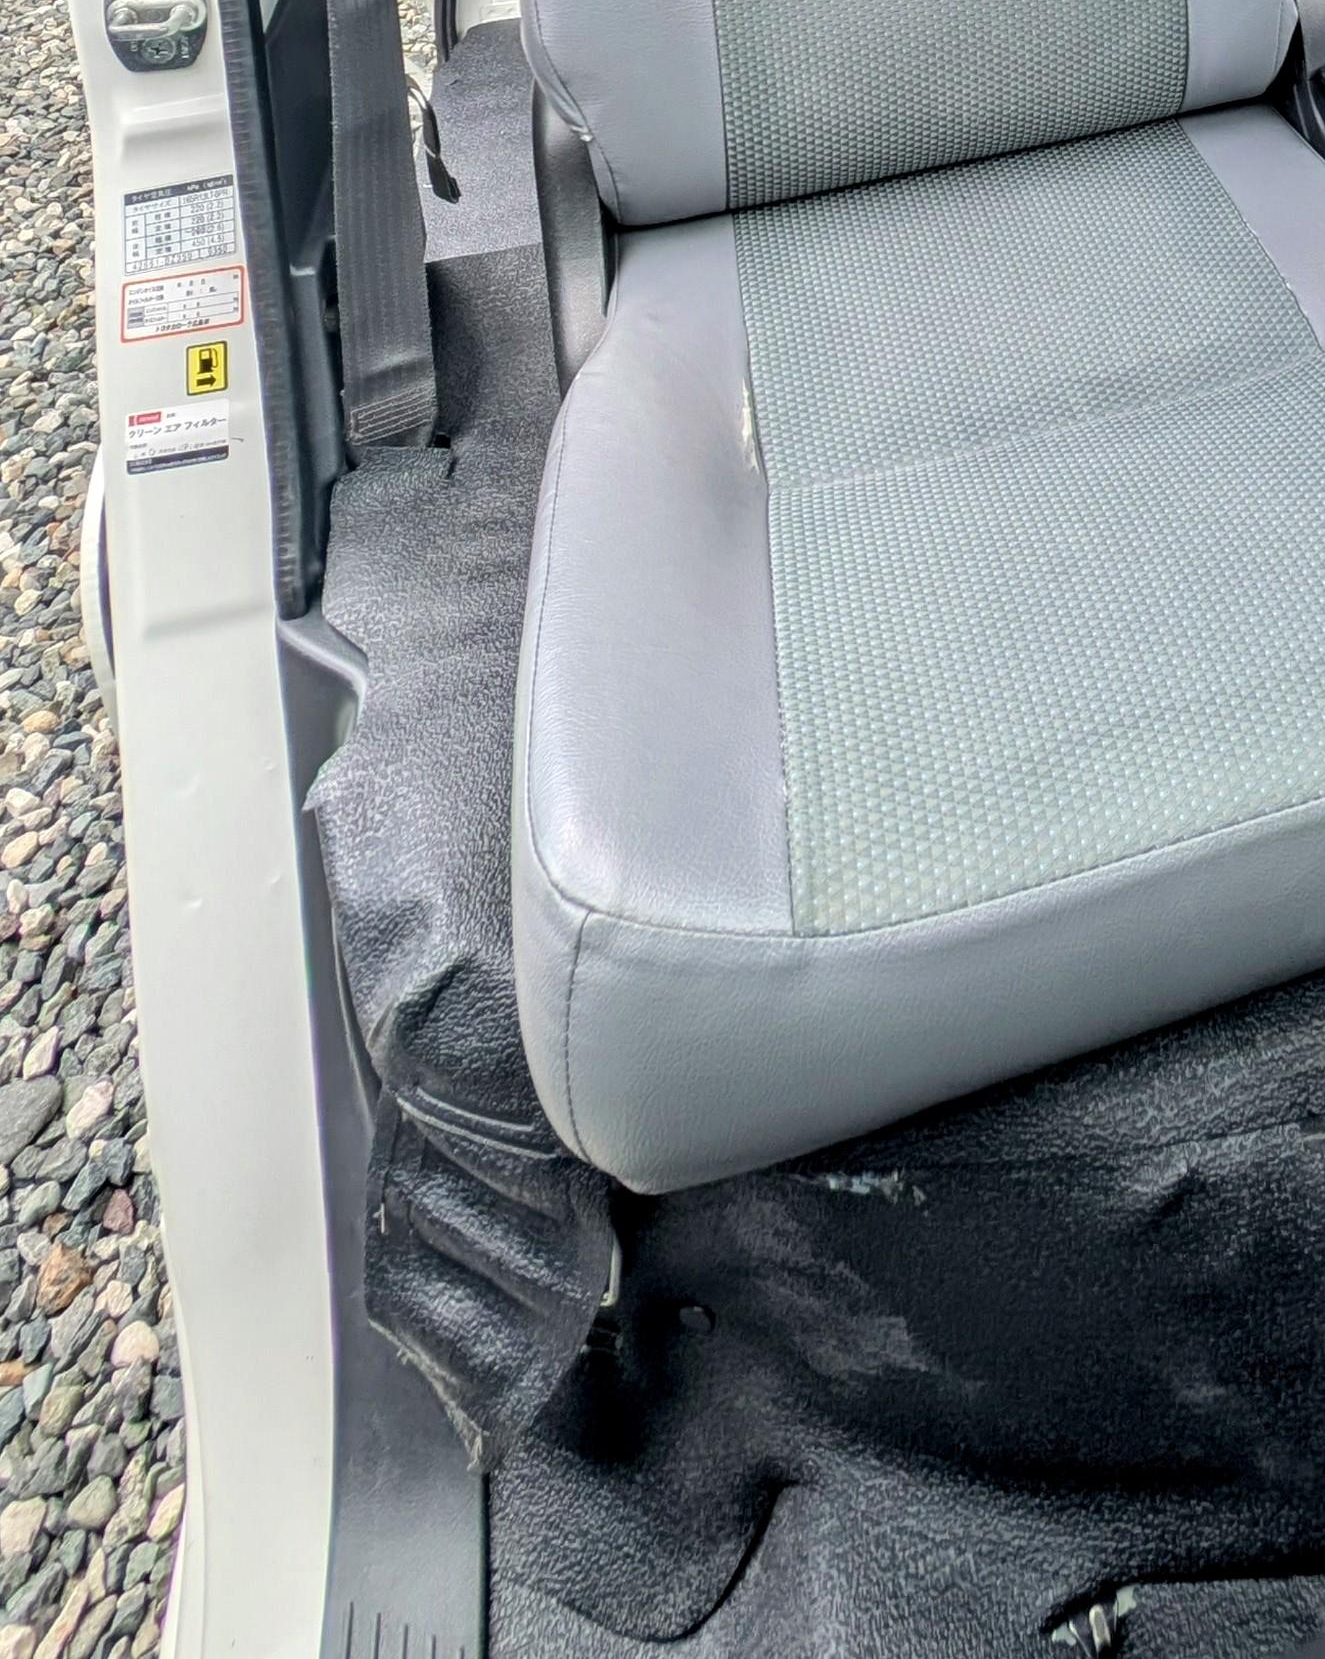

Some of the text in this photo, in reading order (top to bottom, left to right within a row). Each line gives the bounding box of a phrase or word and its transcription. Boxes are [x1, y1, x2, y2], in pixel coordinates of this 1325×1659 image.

[128, 417, 226, 439] クリーン エア フィルター
